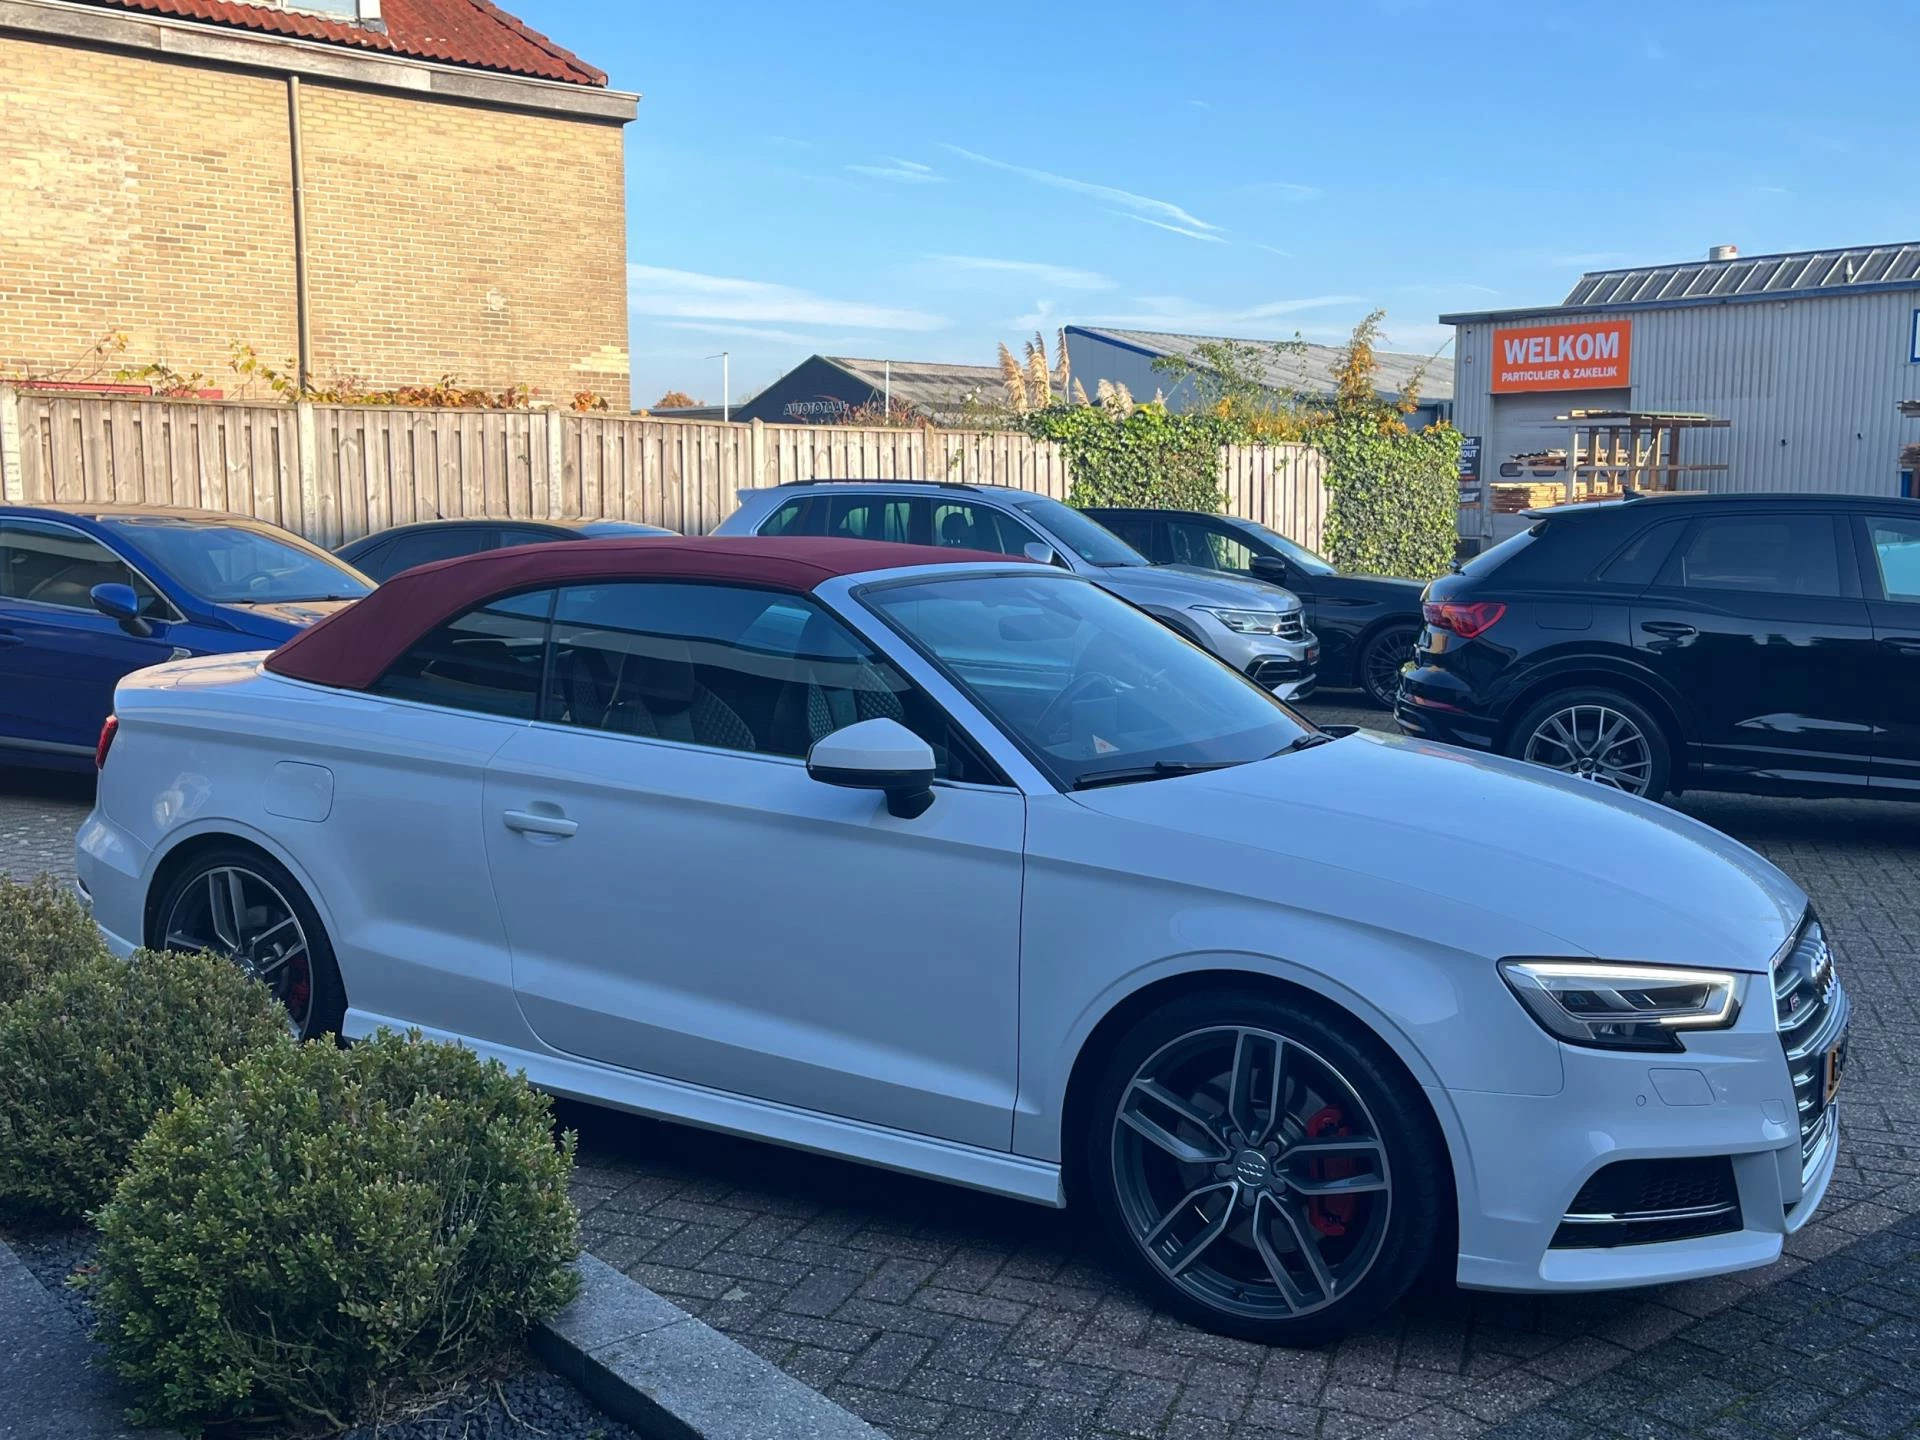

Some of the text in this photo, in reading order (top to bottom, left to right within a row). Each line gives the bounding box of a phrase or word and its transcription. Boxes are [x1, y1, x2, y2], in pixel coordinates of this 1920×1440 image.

[1504, 332, 1619, 364] WELKOM
[1502, 366, 1617, 382] PARTICULIER & ZAKELIJK
